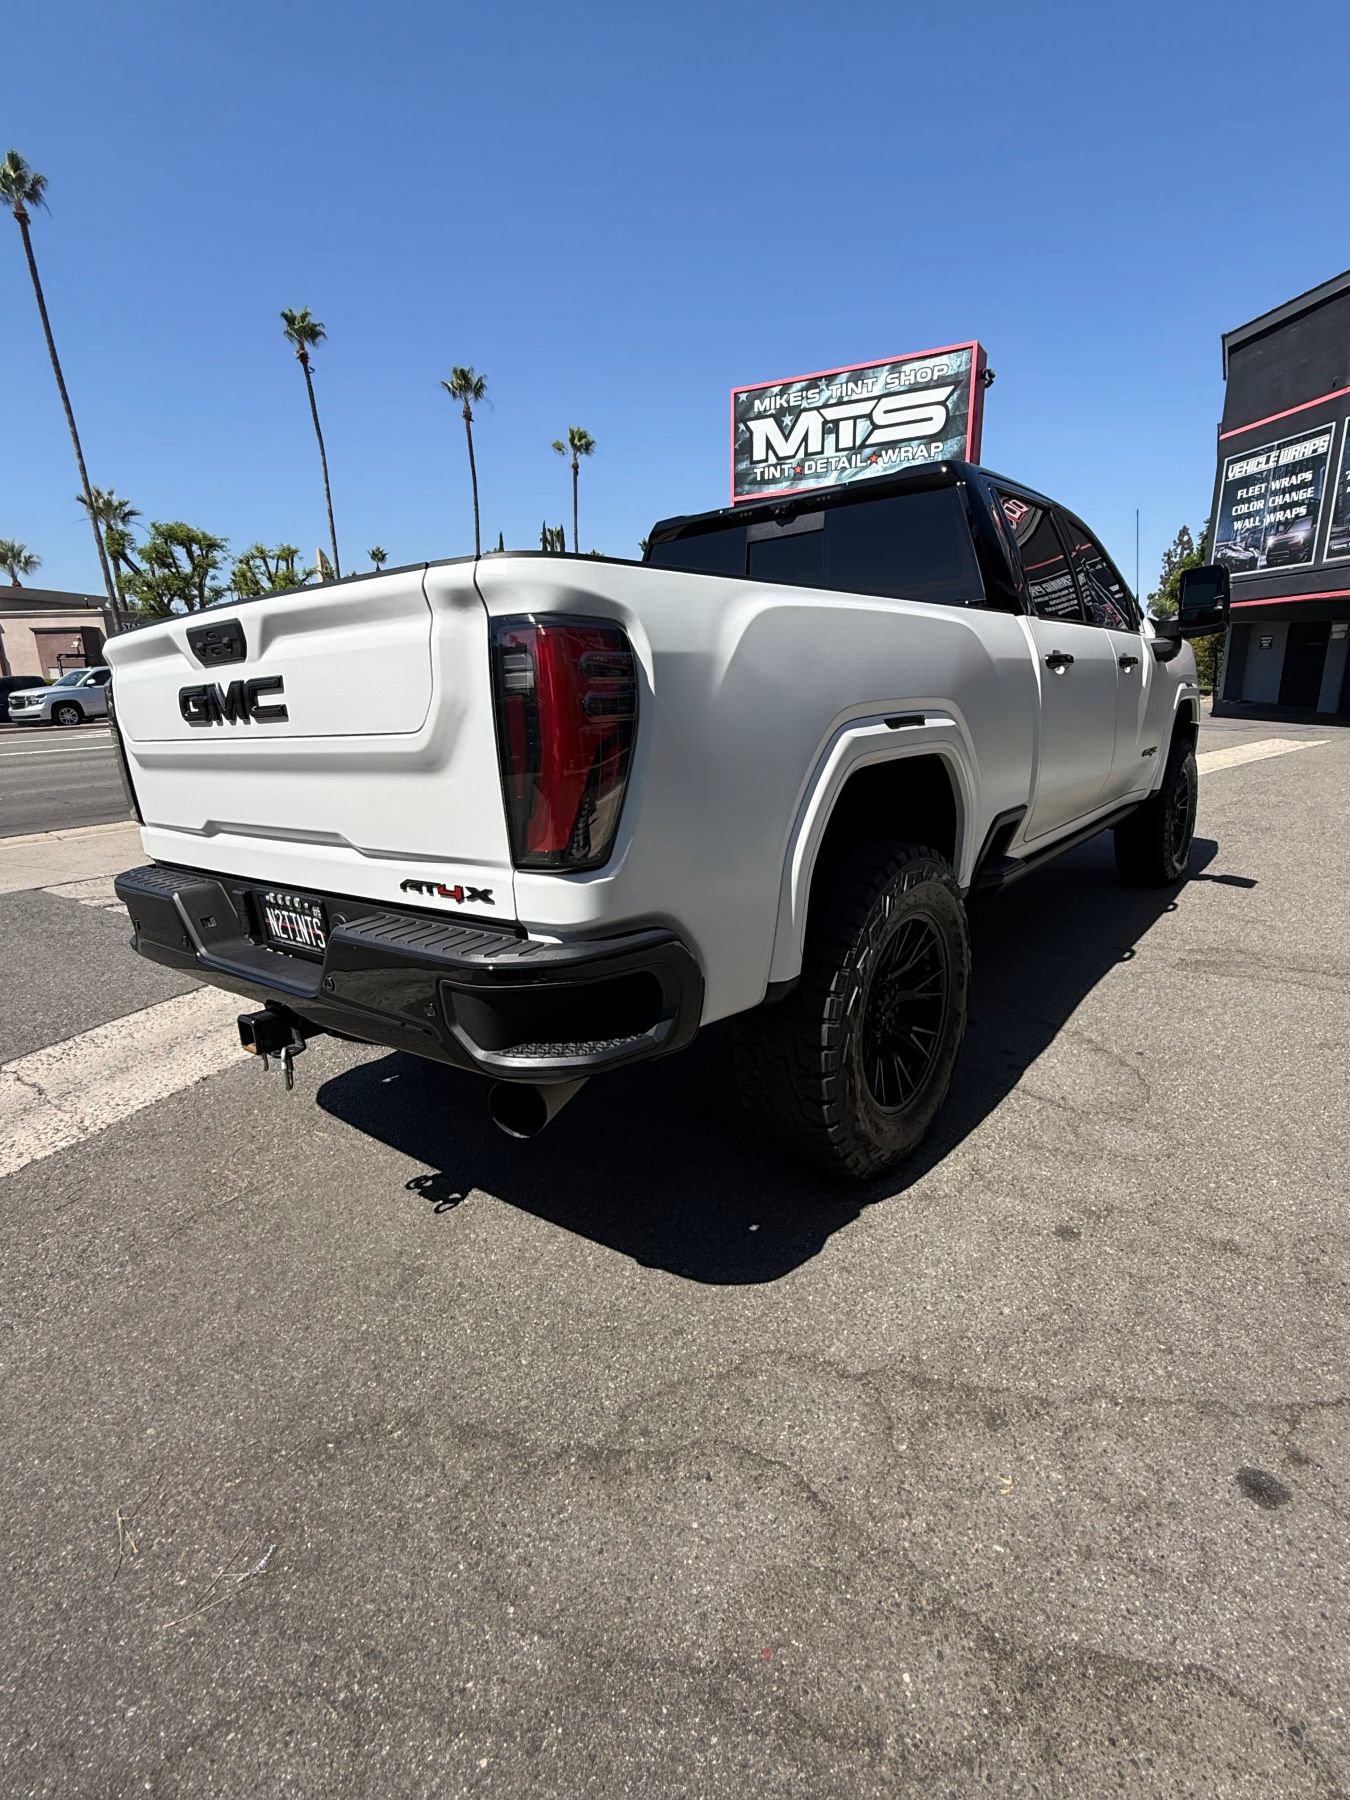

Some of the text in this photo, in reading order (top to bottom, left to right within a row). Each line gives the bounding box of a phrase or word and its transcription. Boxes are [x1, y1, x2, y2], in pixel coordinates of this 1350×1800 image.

[753, 364, 949, 413] MIKE'S TINT SHOP
[748, 384, 957, 463] MTS
[753, 442, 944, 480] TINT DETAIL WRAP
[1227, 434, 1330, 480] VEHICLE WRAPS
[1232, 486, 1315, 516] COLOR CHANGE
[1237, 470, 1313, 500] FLEET WRAPS
[1233, 505, 1307, 531] WALL WRAPS
[179, 675, 289, 727] GMC
[400, 879, 495, 904] AT4X
